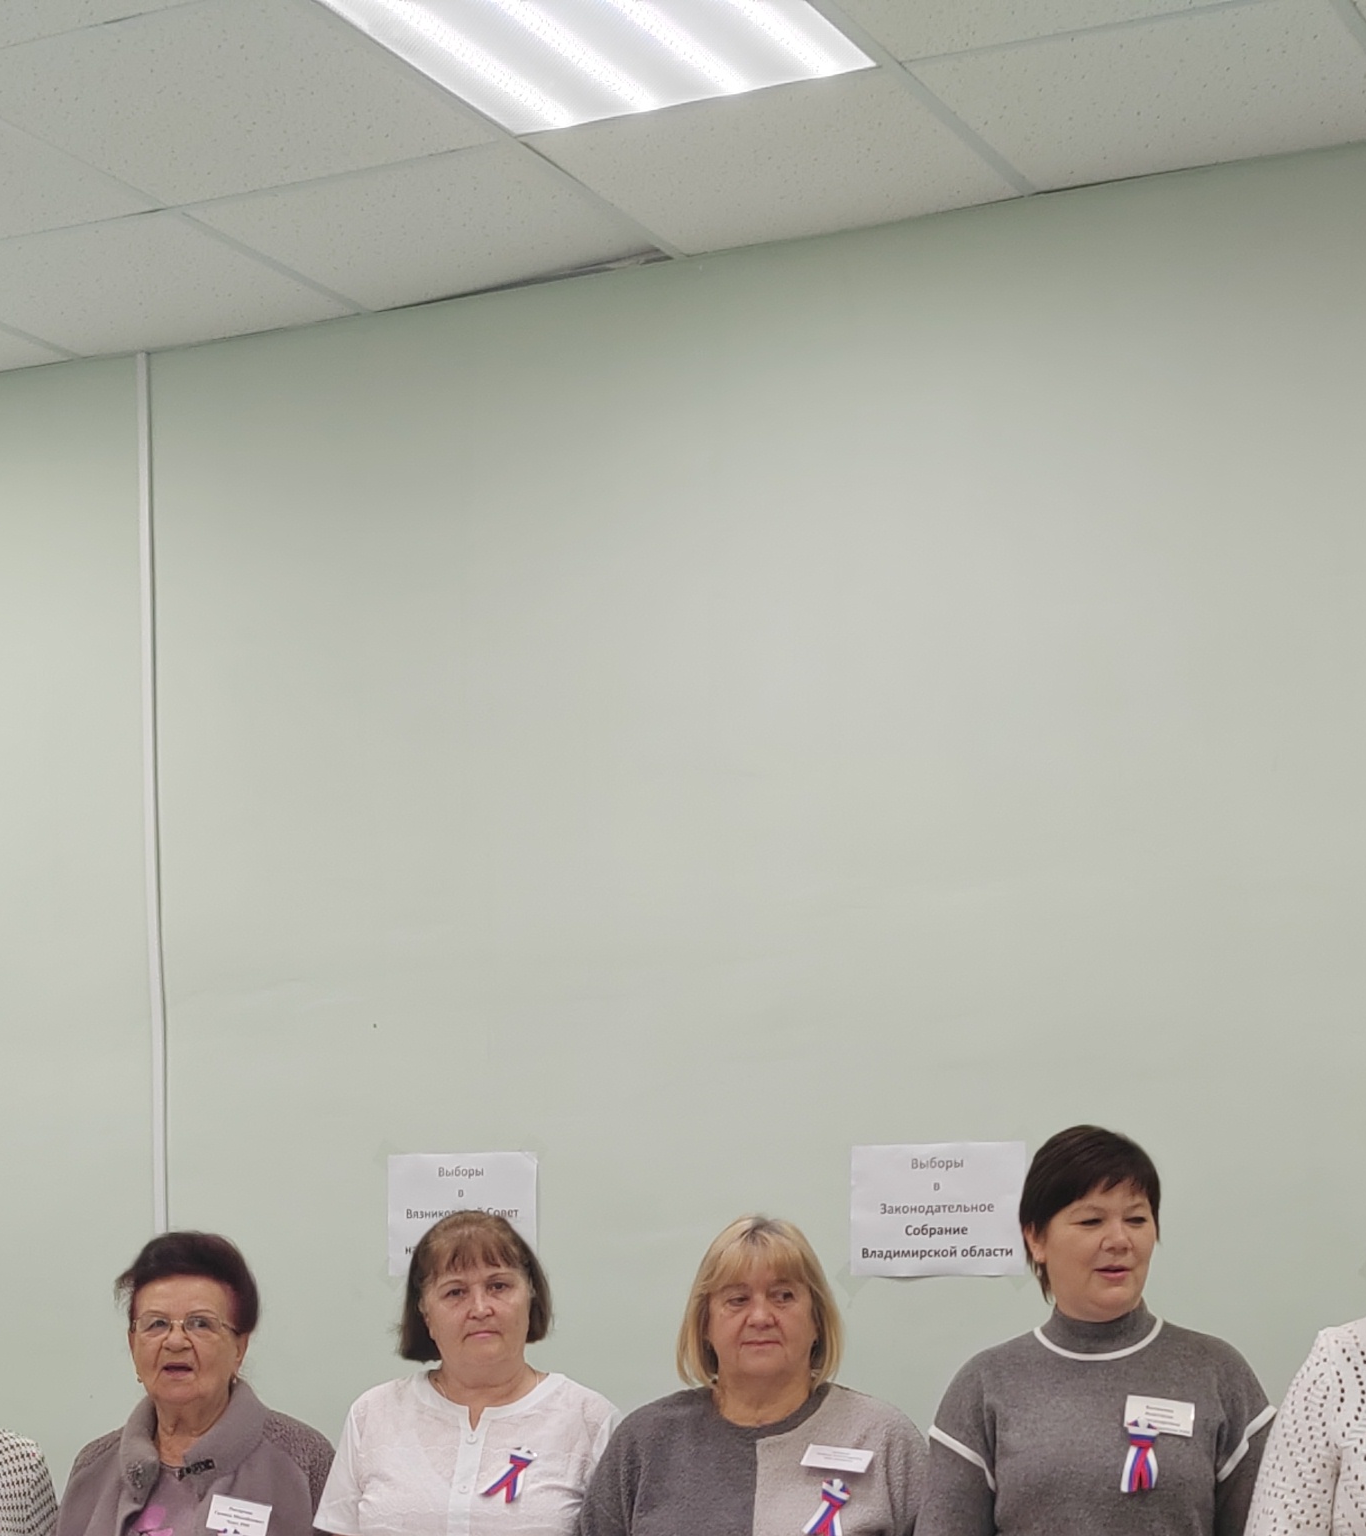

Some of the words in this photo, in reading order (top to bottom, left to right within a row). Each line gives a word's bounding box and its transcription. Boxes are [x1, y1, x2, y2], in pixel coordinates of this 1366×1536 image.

[911, 1157, 964, 1171] Выборы
[438, 1166, 484, 1179] Выборы
[487, 1207, 519, 1219] Совет
[880, 1203, 995, 1215] Законодательное
[905, 1224, 969, 1238] Собрание
[861, 1246, 957, 1260] Владимирской
[961, 1245, 1013, 1258] области
